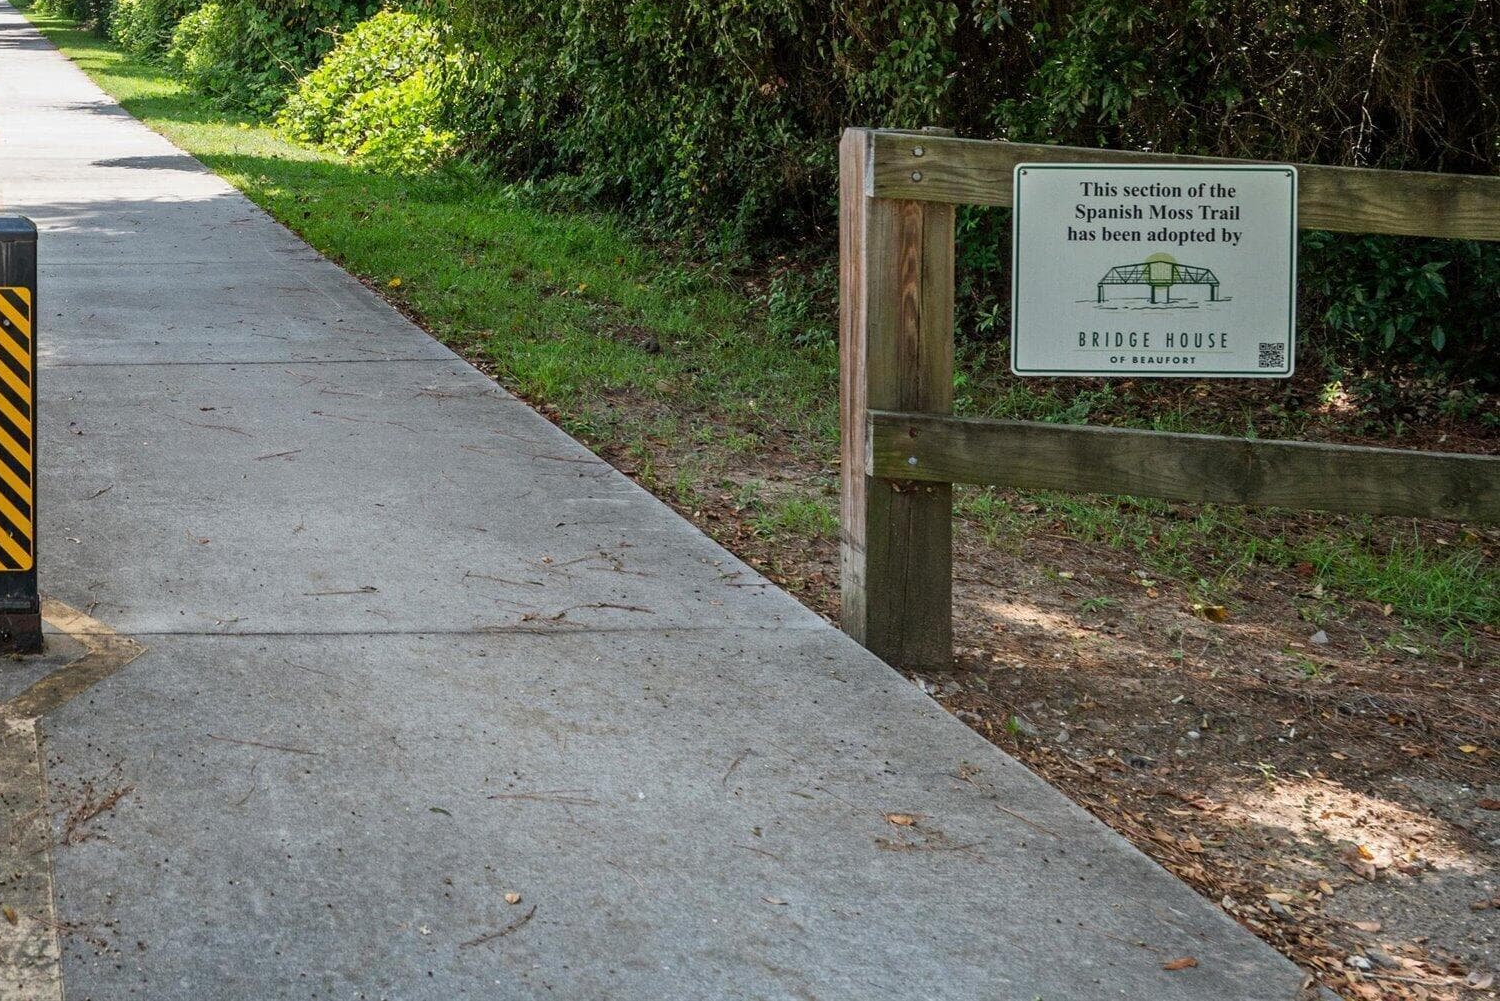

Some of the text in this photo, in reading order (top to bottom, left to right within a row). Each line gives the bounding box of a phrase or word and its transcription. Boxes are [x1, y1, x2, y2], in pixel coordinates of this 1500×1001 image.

[1080, 182, 1237, 198] This section of the
[1075, 204, 1240, 223] Spanish Moss Trail
[1067, 226, 1243, 247] has been adopted by
[1078, 331, 1228, 349] BRIDGE HOUSE
[1109, 356, 1196, 365] OF BEAUFORT
